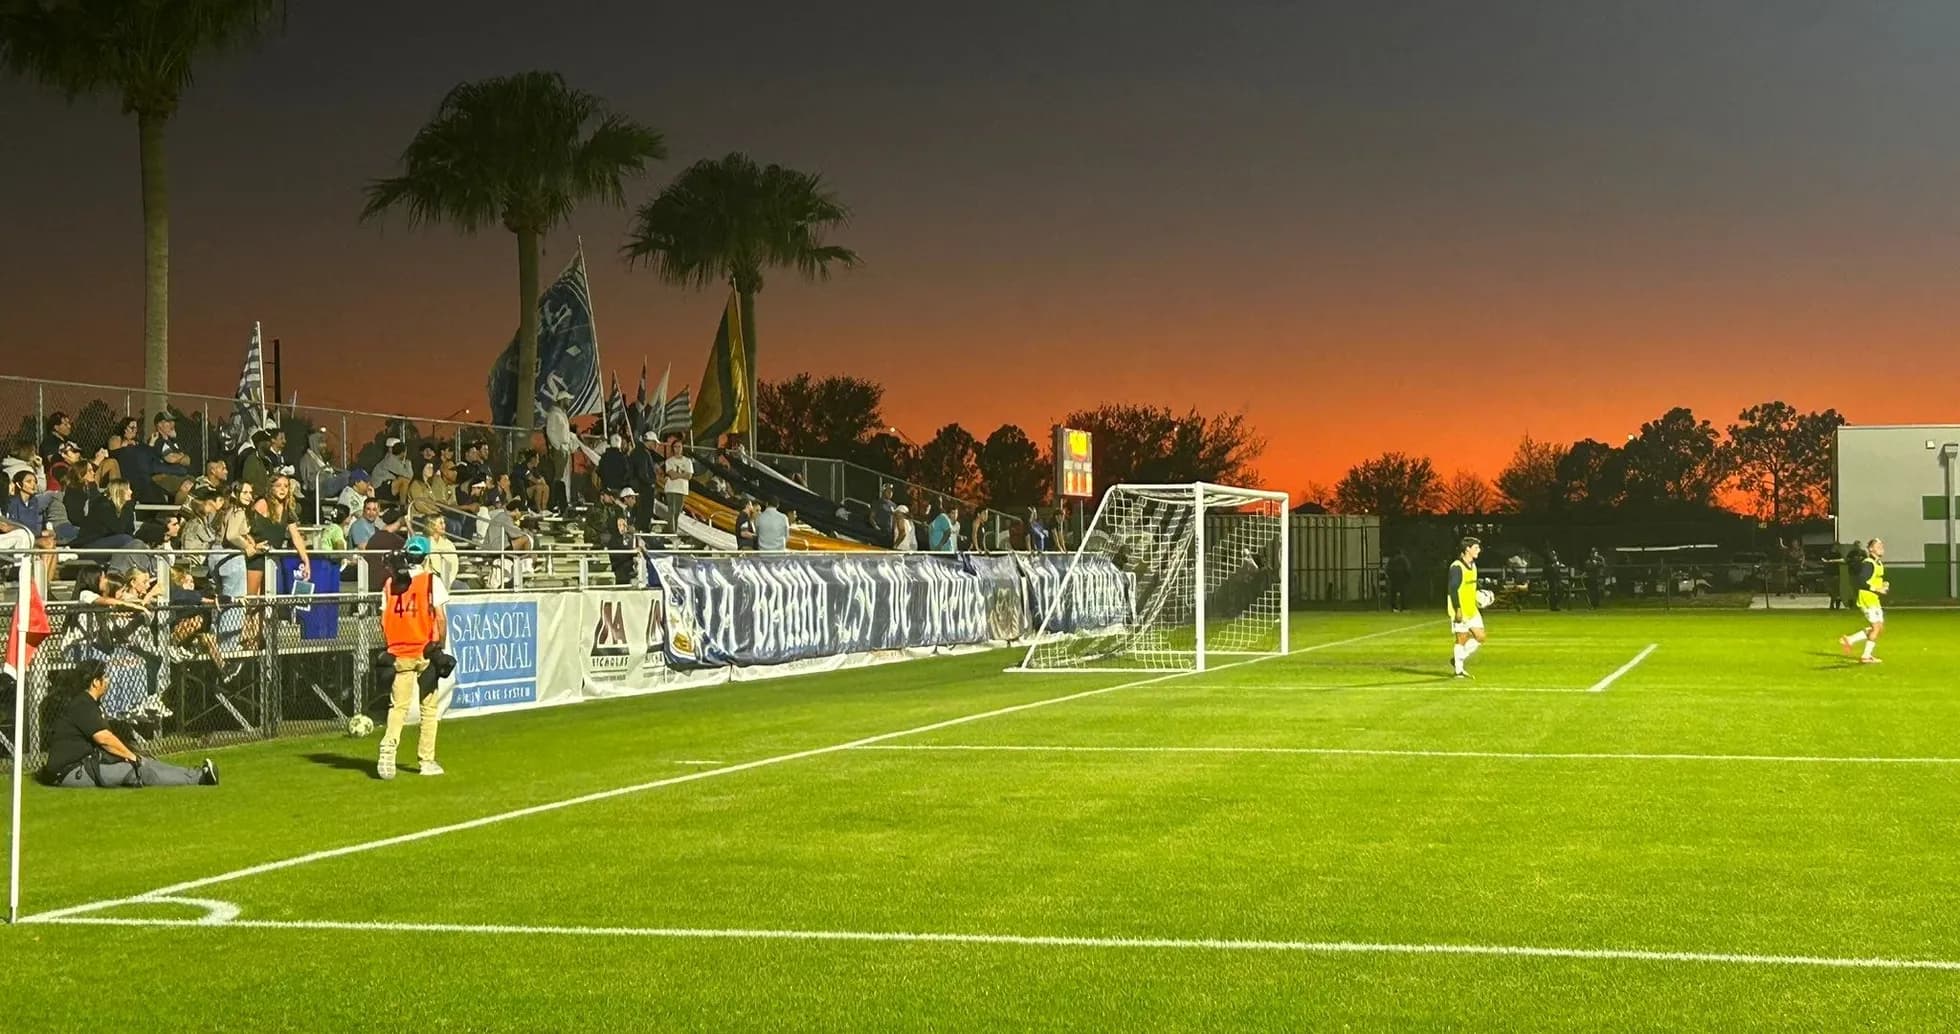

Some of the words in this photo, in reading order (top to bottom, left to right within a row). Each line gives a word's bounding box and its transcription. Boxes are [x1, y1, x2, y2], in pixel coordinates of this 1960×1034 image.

[394, 593, 417, 618] 44
[917, 559, 987, 643] NAPLES
[452, 611, 531, 642] SARASOTA
[592, 656, 628, 668] NICHOLAS
